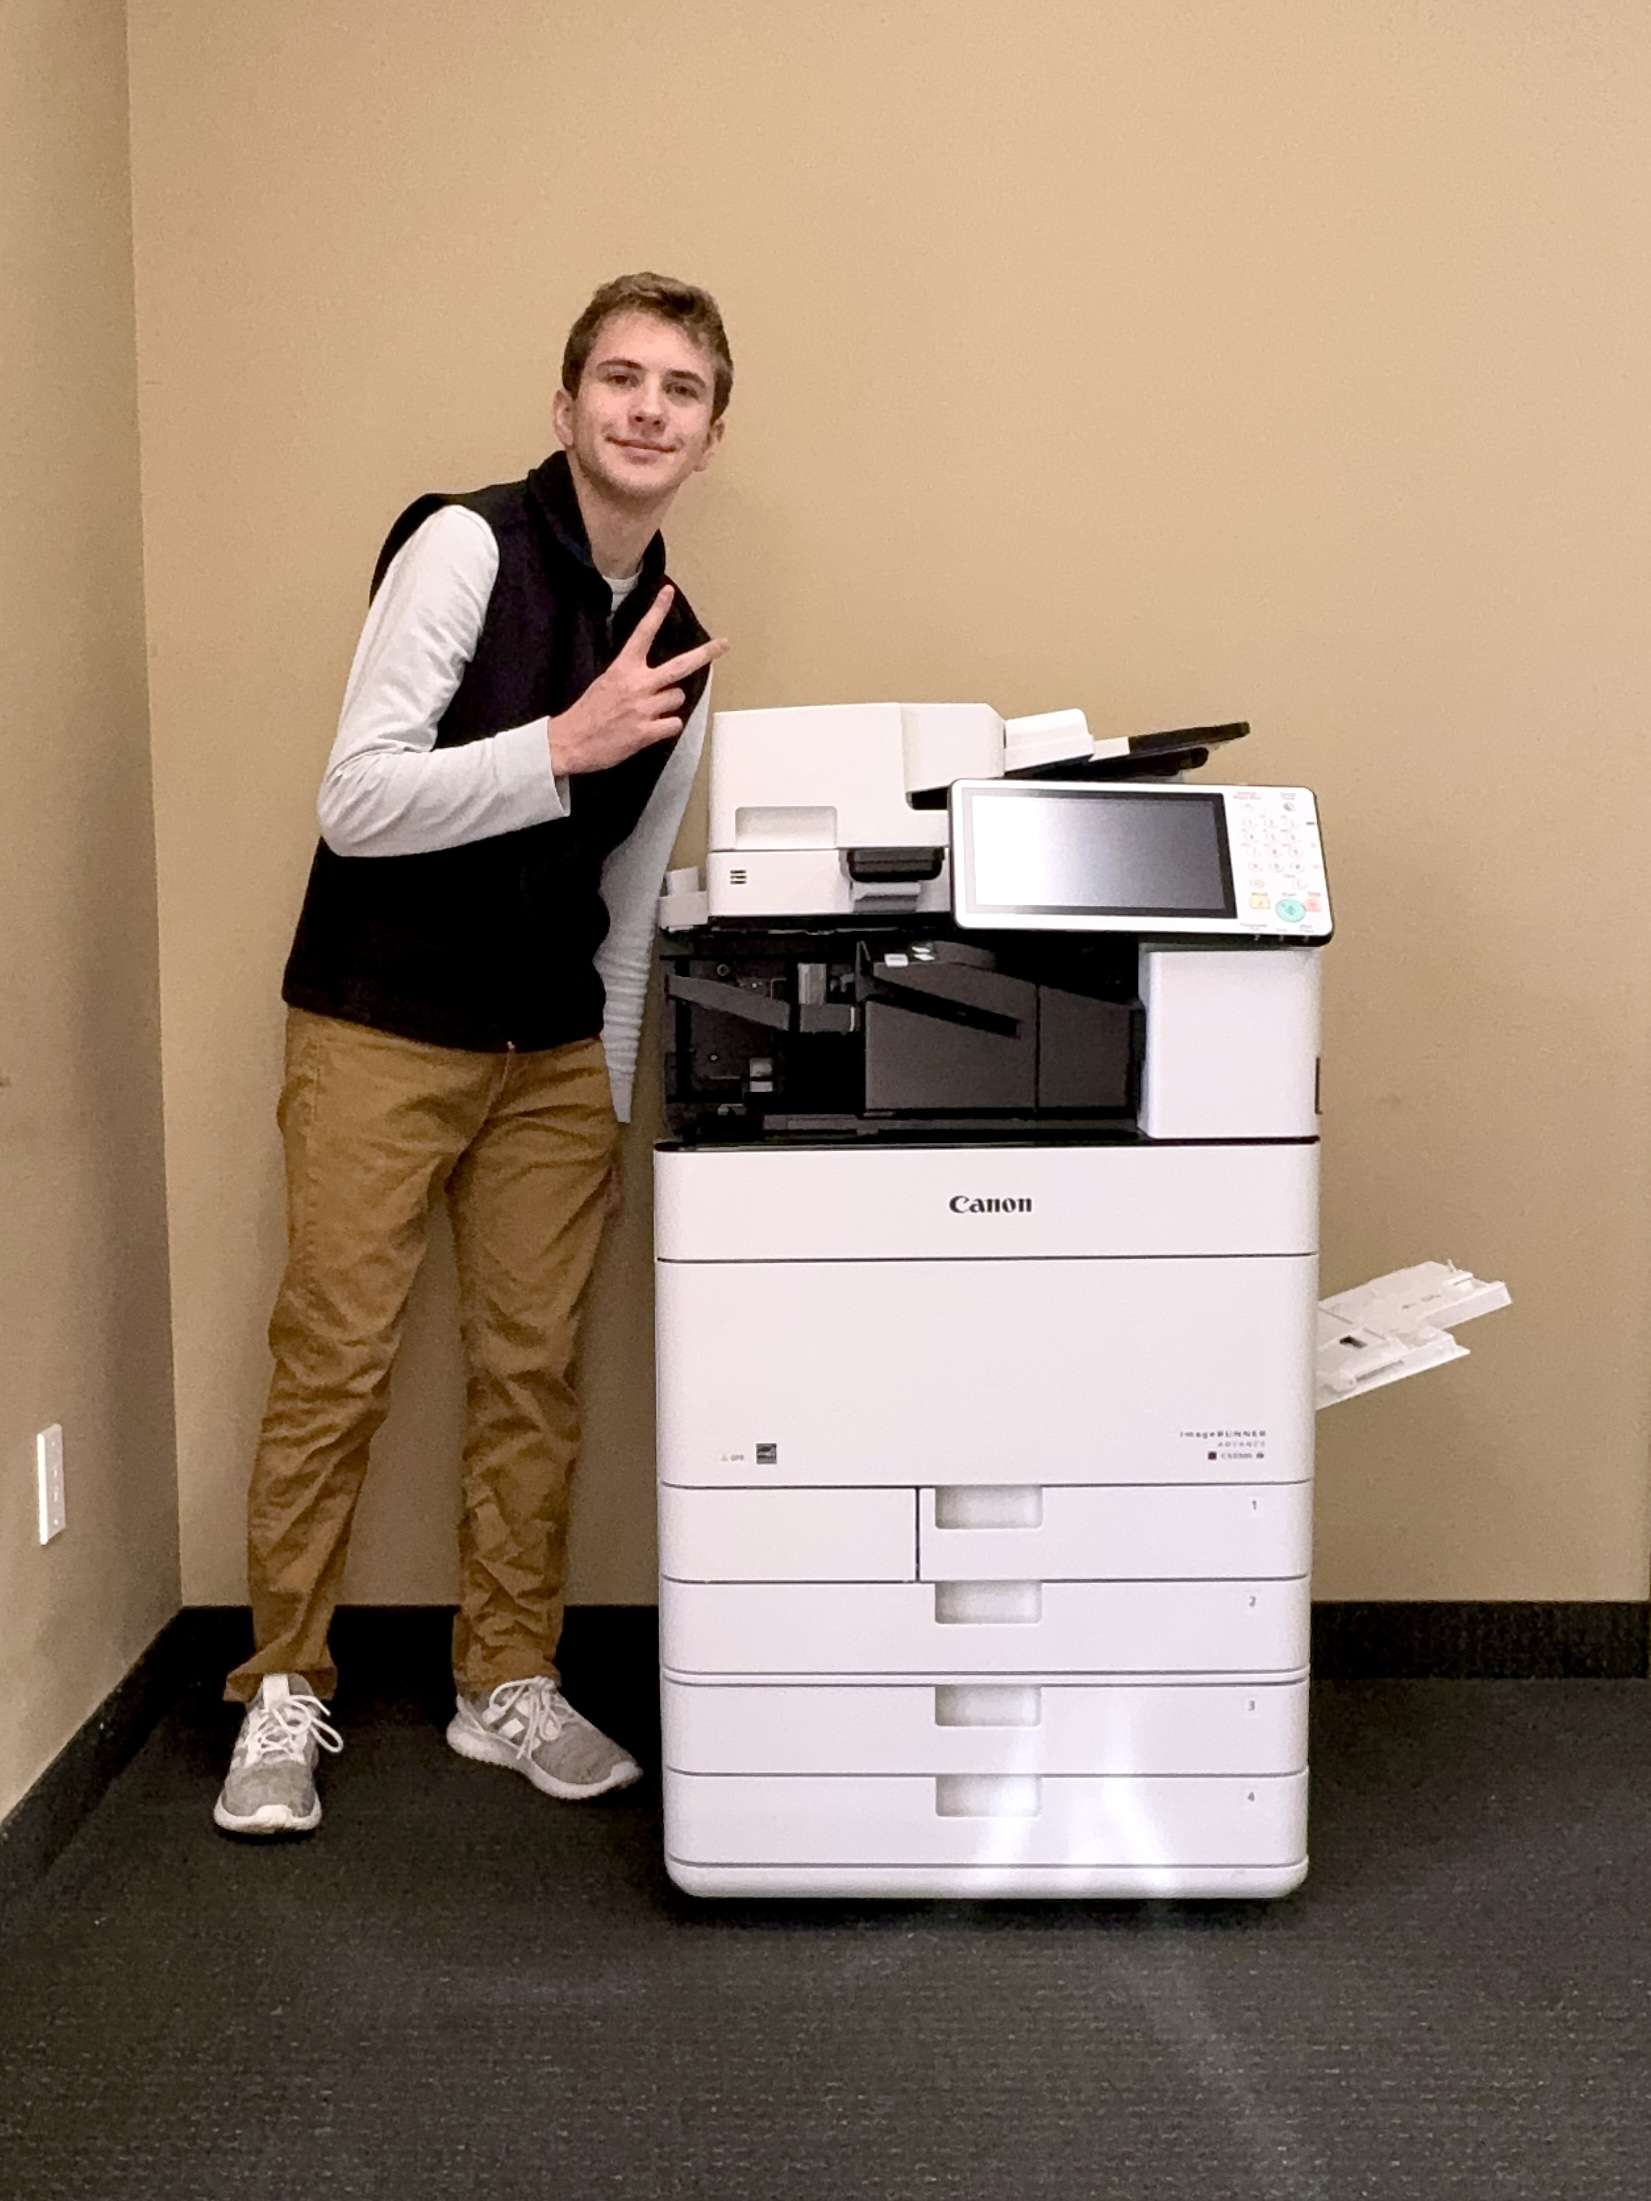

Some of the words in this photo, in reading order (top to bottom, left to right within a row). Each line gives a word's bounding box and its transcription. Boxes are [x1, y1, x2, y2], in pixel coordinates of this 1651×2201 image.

[949, 1195, 1032, 1213] Canon
[1251, 1500, 1257, 1511] 1
[1248, 1596, 1257, 1608] 2
[1248, 1700, 1256, 1711] 3
[1247, 1791, 1256, 1803] 4
